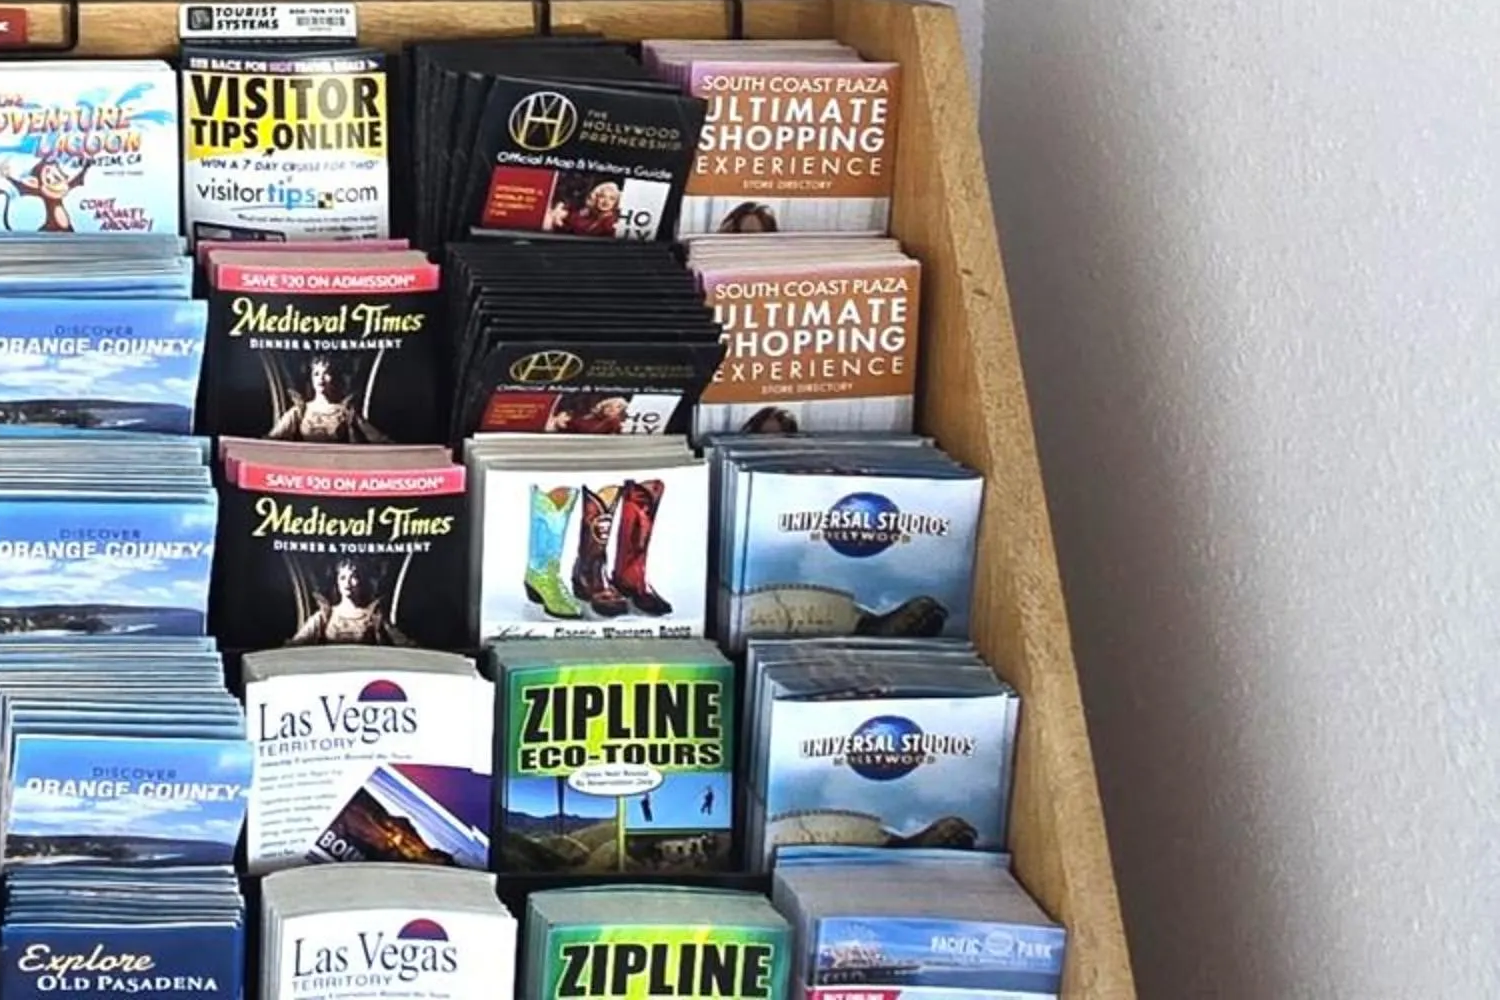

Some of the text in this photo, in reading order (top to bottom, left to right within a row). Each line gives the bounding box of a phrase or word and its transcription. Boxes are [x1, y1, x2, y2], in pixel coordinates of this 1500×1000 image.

[215, 7, 277, 17] TOURIST
[217, 19, 279, 30] SYSTEMS
[702, 75, 888, 92] SOUTH COAST PLAZA
[190, 75, 379, 119] VISITOR
[190, 119, 382, 150] TIPS ONLINE
[583, 121, 680, 139] HOLLYWOOD
[698, 125, 885, 152] SHOPPING
[579, 131, 682, 150] PARTNERSHIP
[201, 159, 226, 169] WIN
[229, 160, 239, 169] A
[242, 160, 250, 170] 7
[255, 161, 278, 171] DAY
[634, 166, 673, 179] Guide
[696, 156, 882, 175] EXPERIENCE
[197, 178, 378, 210] visitortips.com
[743, 180, 774, 189] STORE
[241, 274, 278, 287] SAVE
[308, 276, 330, 287] ON
[715, 278, 908, 299] SOUTH COAST PLAZA
[229, 296, 425, 338] Medieval Times
[714, 298, 907, 330] ULTIMATE
[55, 325, 133, 336] DISCOVER
[98, 338, 194, 356] COUNTY
[250, 338, 299, 349] DINNER
[314, 338, 402, 349] TOURNAMENT
[252, 497, 454, 542] Medieval Times
[779, 511, 951, 536] UNIVERSAL STUDIOS
[60, 528, 141, 539] DISCOVER
[106, 541, 204, 558] COUNTY
[273, 540, 324, 552] DINNER
[339, 541, 431, 553] TOURNAMENT
[260, 695, 418, 744] Las Vegas
[523, 682, 722, 744] ZIPLINE
[259, 738, 357, 757] TERRITORY
[802, 734, 975, 758] UNIVERSAL STUDIOS
[520, 743, 722, 770] ECO-TOURS
[18, 944, 156, 978] Explore
[294, 931, 458, 982] Las Vegas
[558, 943, 773, 997] ZIPLINE
[36, 976, 218, 992] OLD PASADENA
[292, 975, 393, 992] TERRITORY
